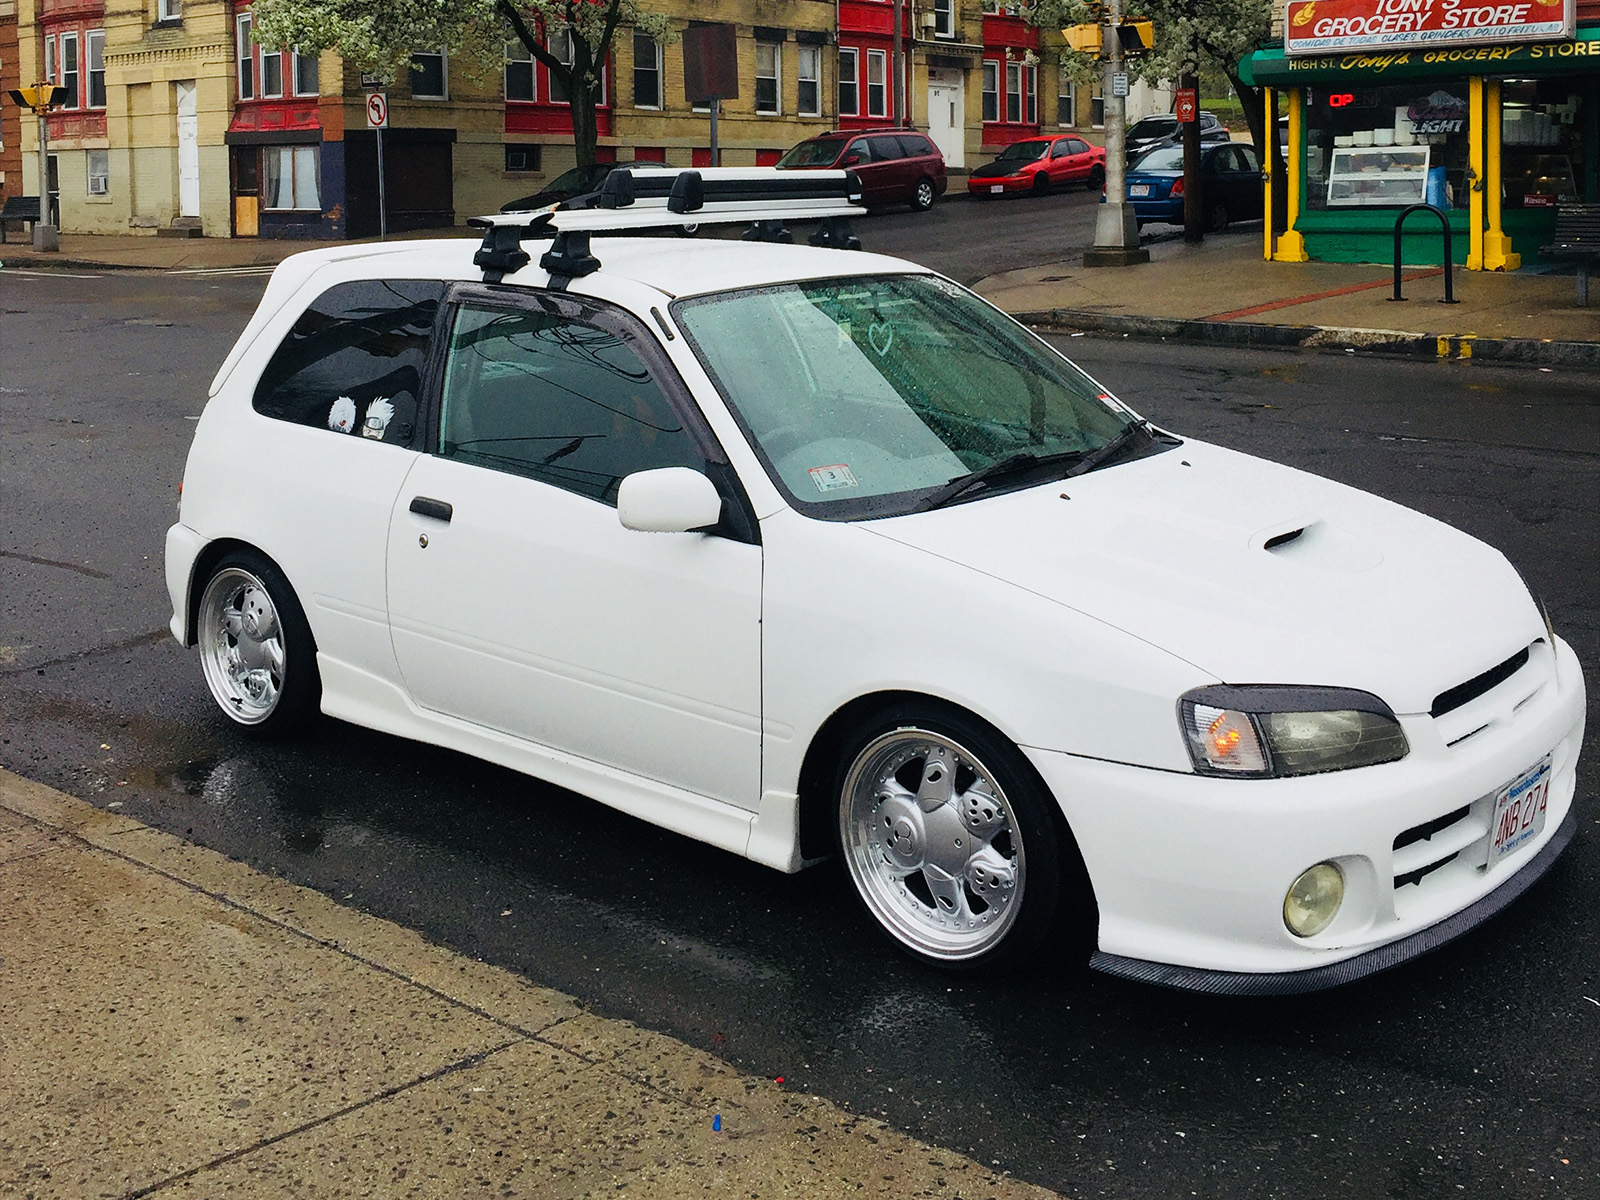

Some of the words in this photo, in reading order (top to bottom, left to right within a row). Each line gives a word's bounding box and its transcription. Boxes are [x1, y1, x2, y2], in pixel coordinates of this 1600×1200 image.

[1375, 0, 1460, 14] TONYS
[1313, 12, 1432, 37] GROCERY
[1441, 4, 1532, 29] STORE
[1292, 38, 1331, 48] COMIDAS
[1333, 37, 1346, 46] DE
[1349, 35, 1377, 45] TODAS
[1381, 32, 1418, 42] CLASES
[1420, 29, 1471, 41] GRINDERS
[1473, 27, 1507, 37] POLLO
[1288, 59, 1317, 70] HIGH
[1339, 52, 1411, 73] Tony's
[1423, 45, 1523, 63] GROCERY
[1530, 41, 1600, 58] STORE
[1410, 119, 1463, 133] LIGHT
[1521, 779, 1549, 830] 274
